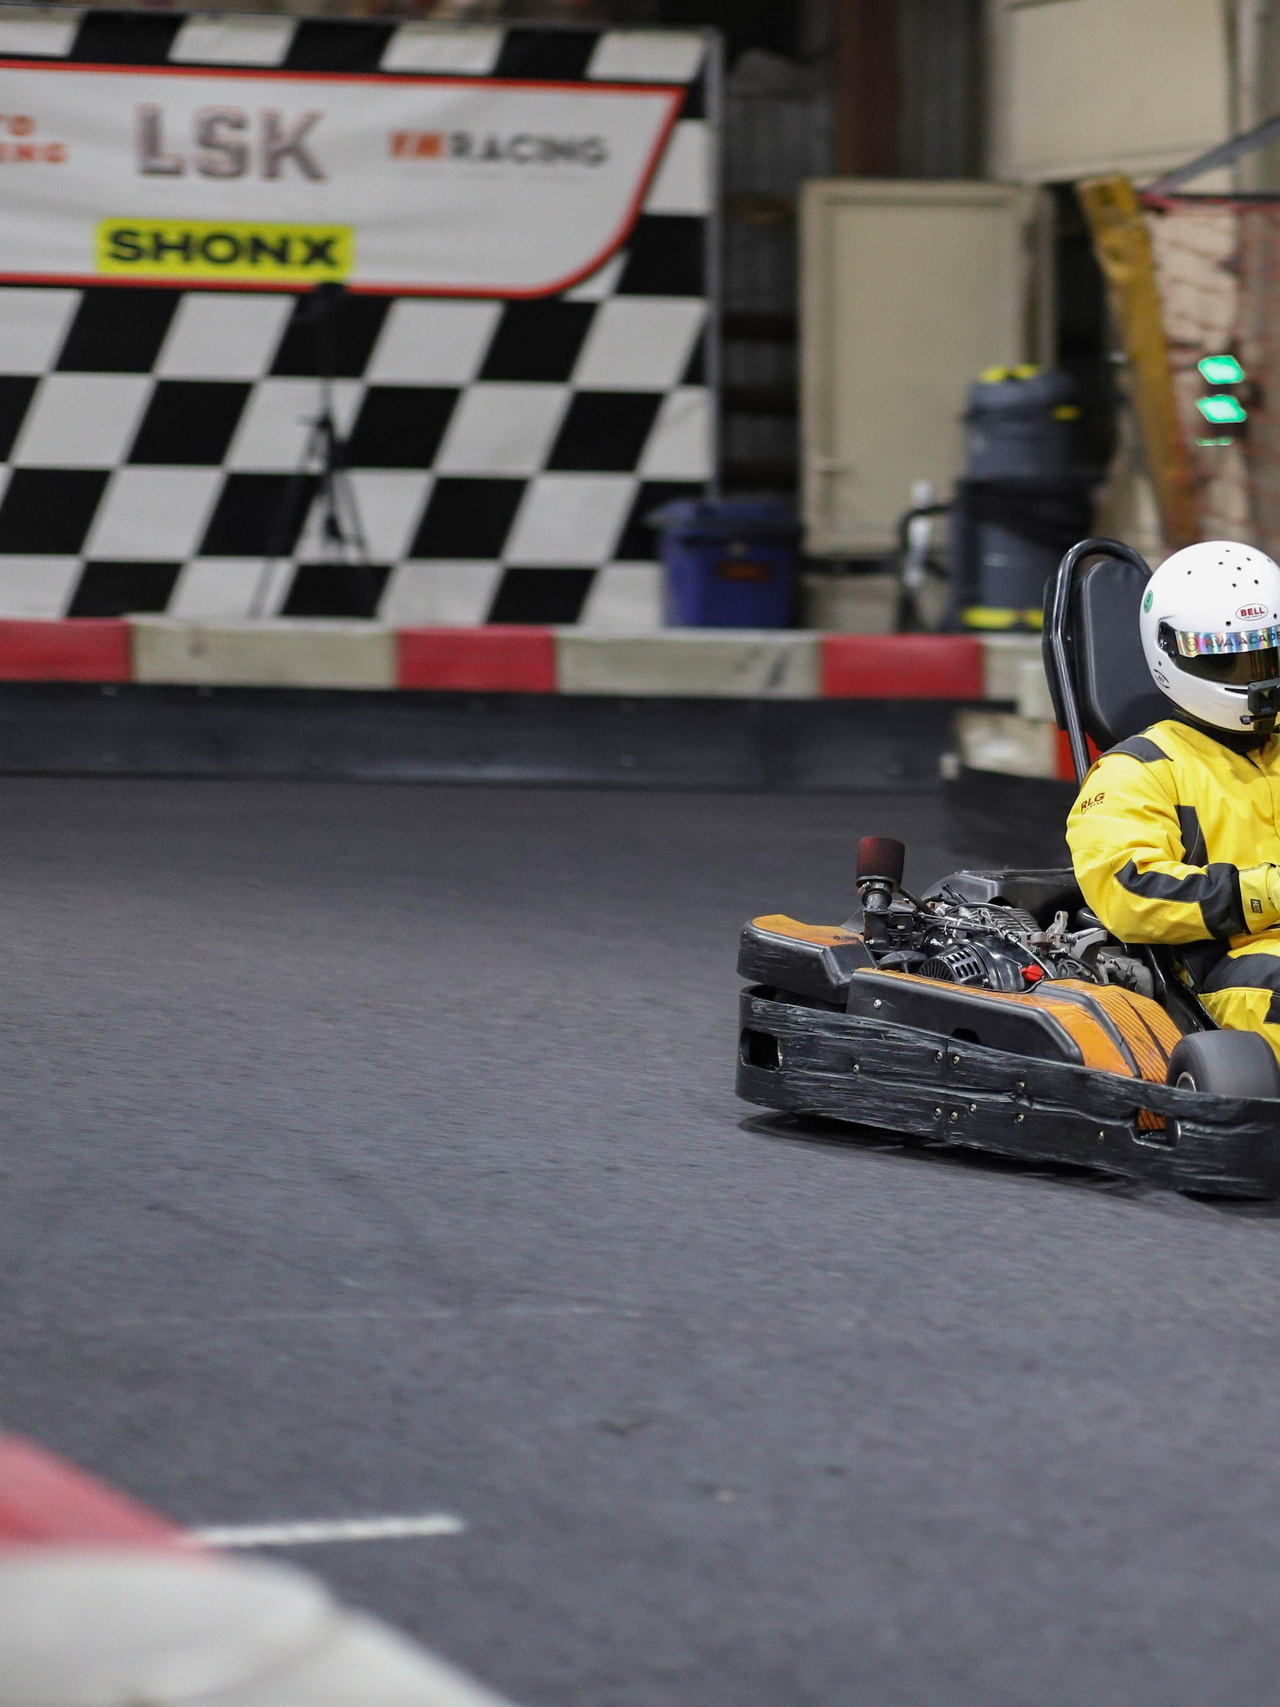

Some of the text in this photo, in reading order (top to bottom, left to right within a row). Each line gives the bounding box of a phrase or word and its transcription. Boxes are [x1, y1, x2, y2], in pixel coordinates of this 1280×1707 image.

[135, 102, 327, 184] LSK
[109, 228, 340, 269] SHONX
[1240, 606, 1265, 617] BELL
[1080, 792, 1105, 812] RLG
